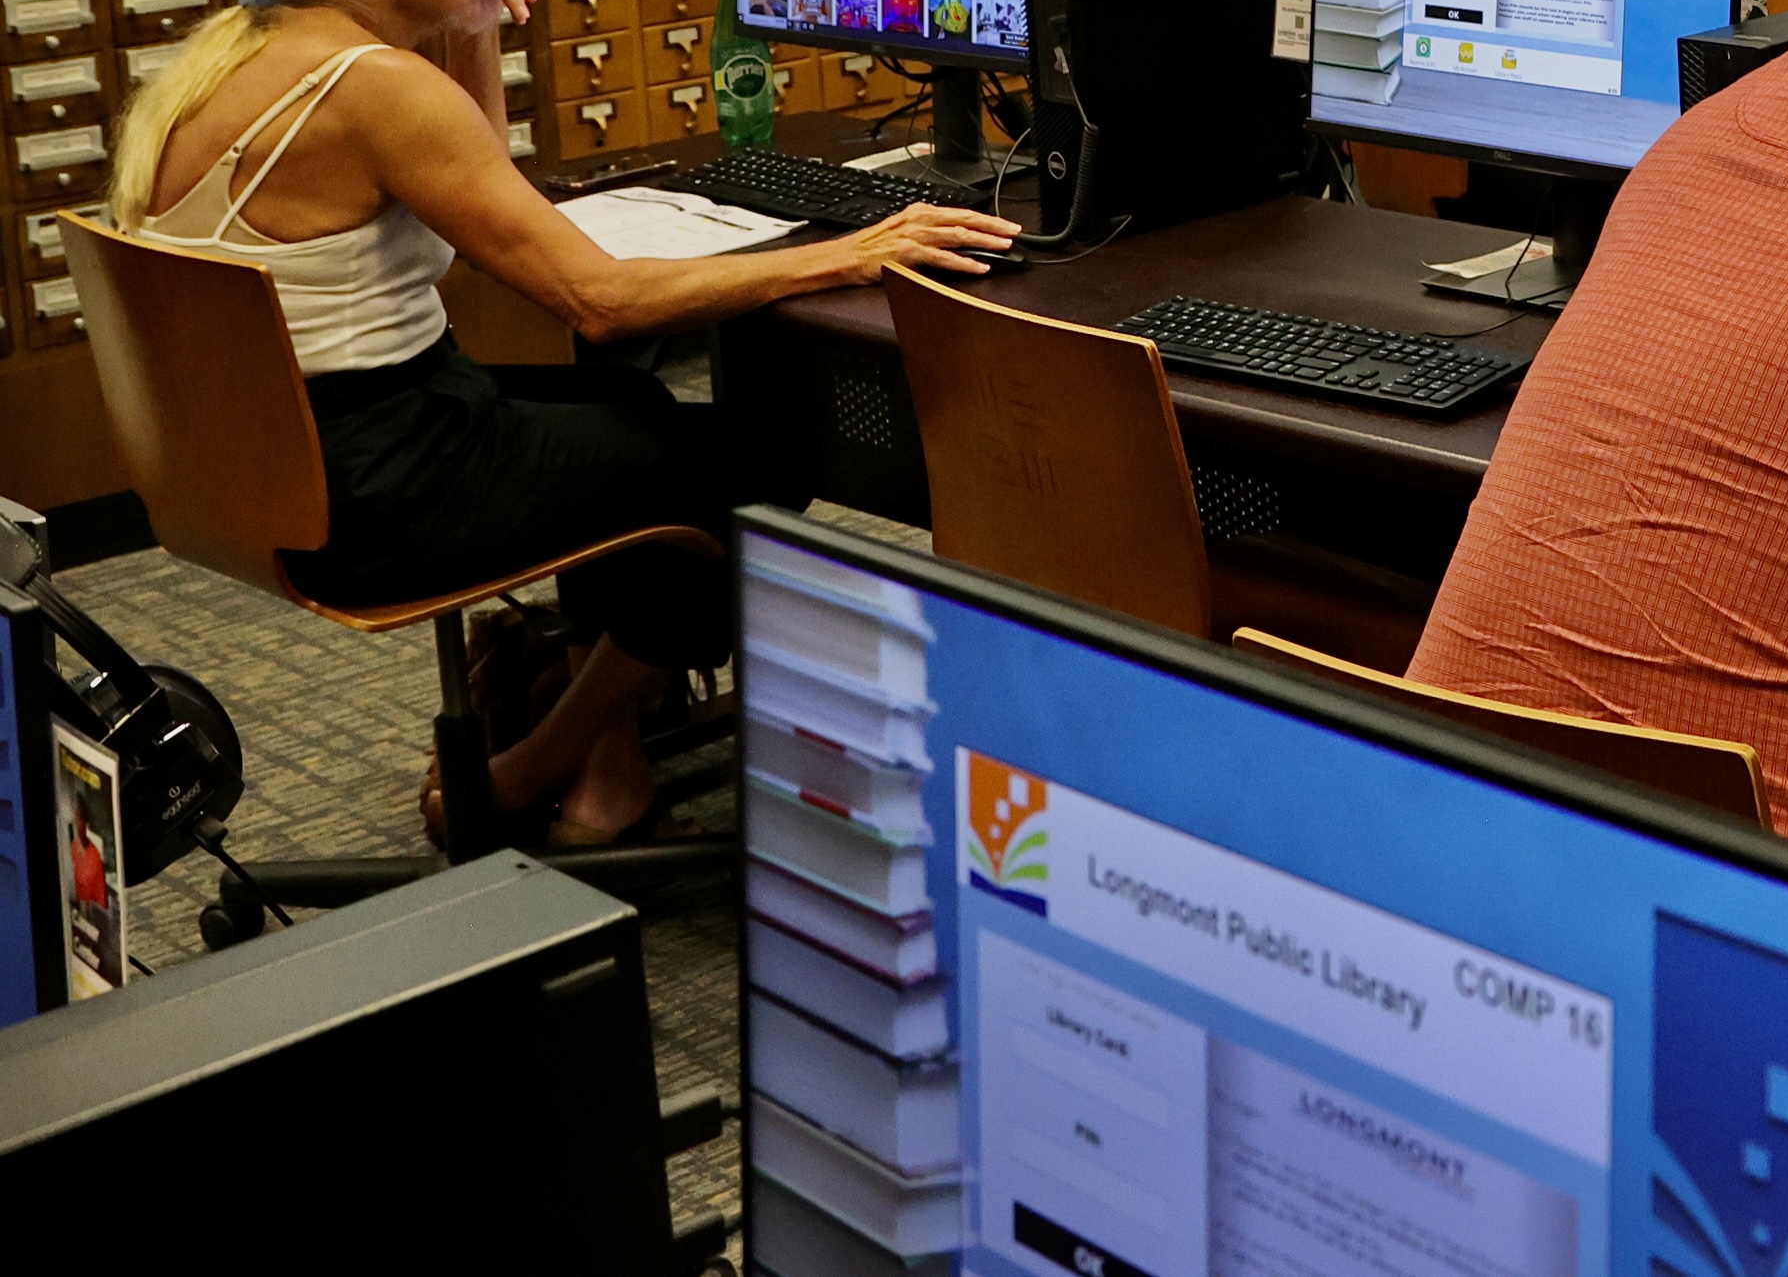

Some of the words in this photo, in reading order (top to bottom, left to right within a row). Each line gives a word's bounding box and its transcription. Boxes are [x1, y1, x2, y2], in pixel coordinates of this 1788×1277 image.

[1448, 10, 1460, 20] OK
[1087, 852, 1220, 944] Longmont
[1227, 910, 1313, 980] Public
[1321, 949, 1427, 1030] Library
[1454, 957, 1555, 1022] COMP
[1300, 1088, 1469, 1182] LONGMONT
